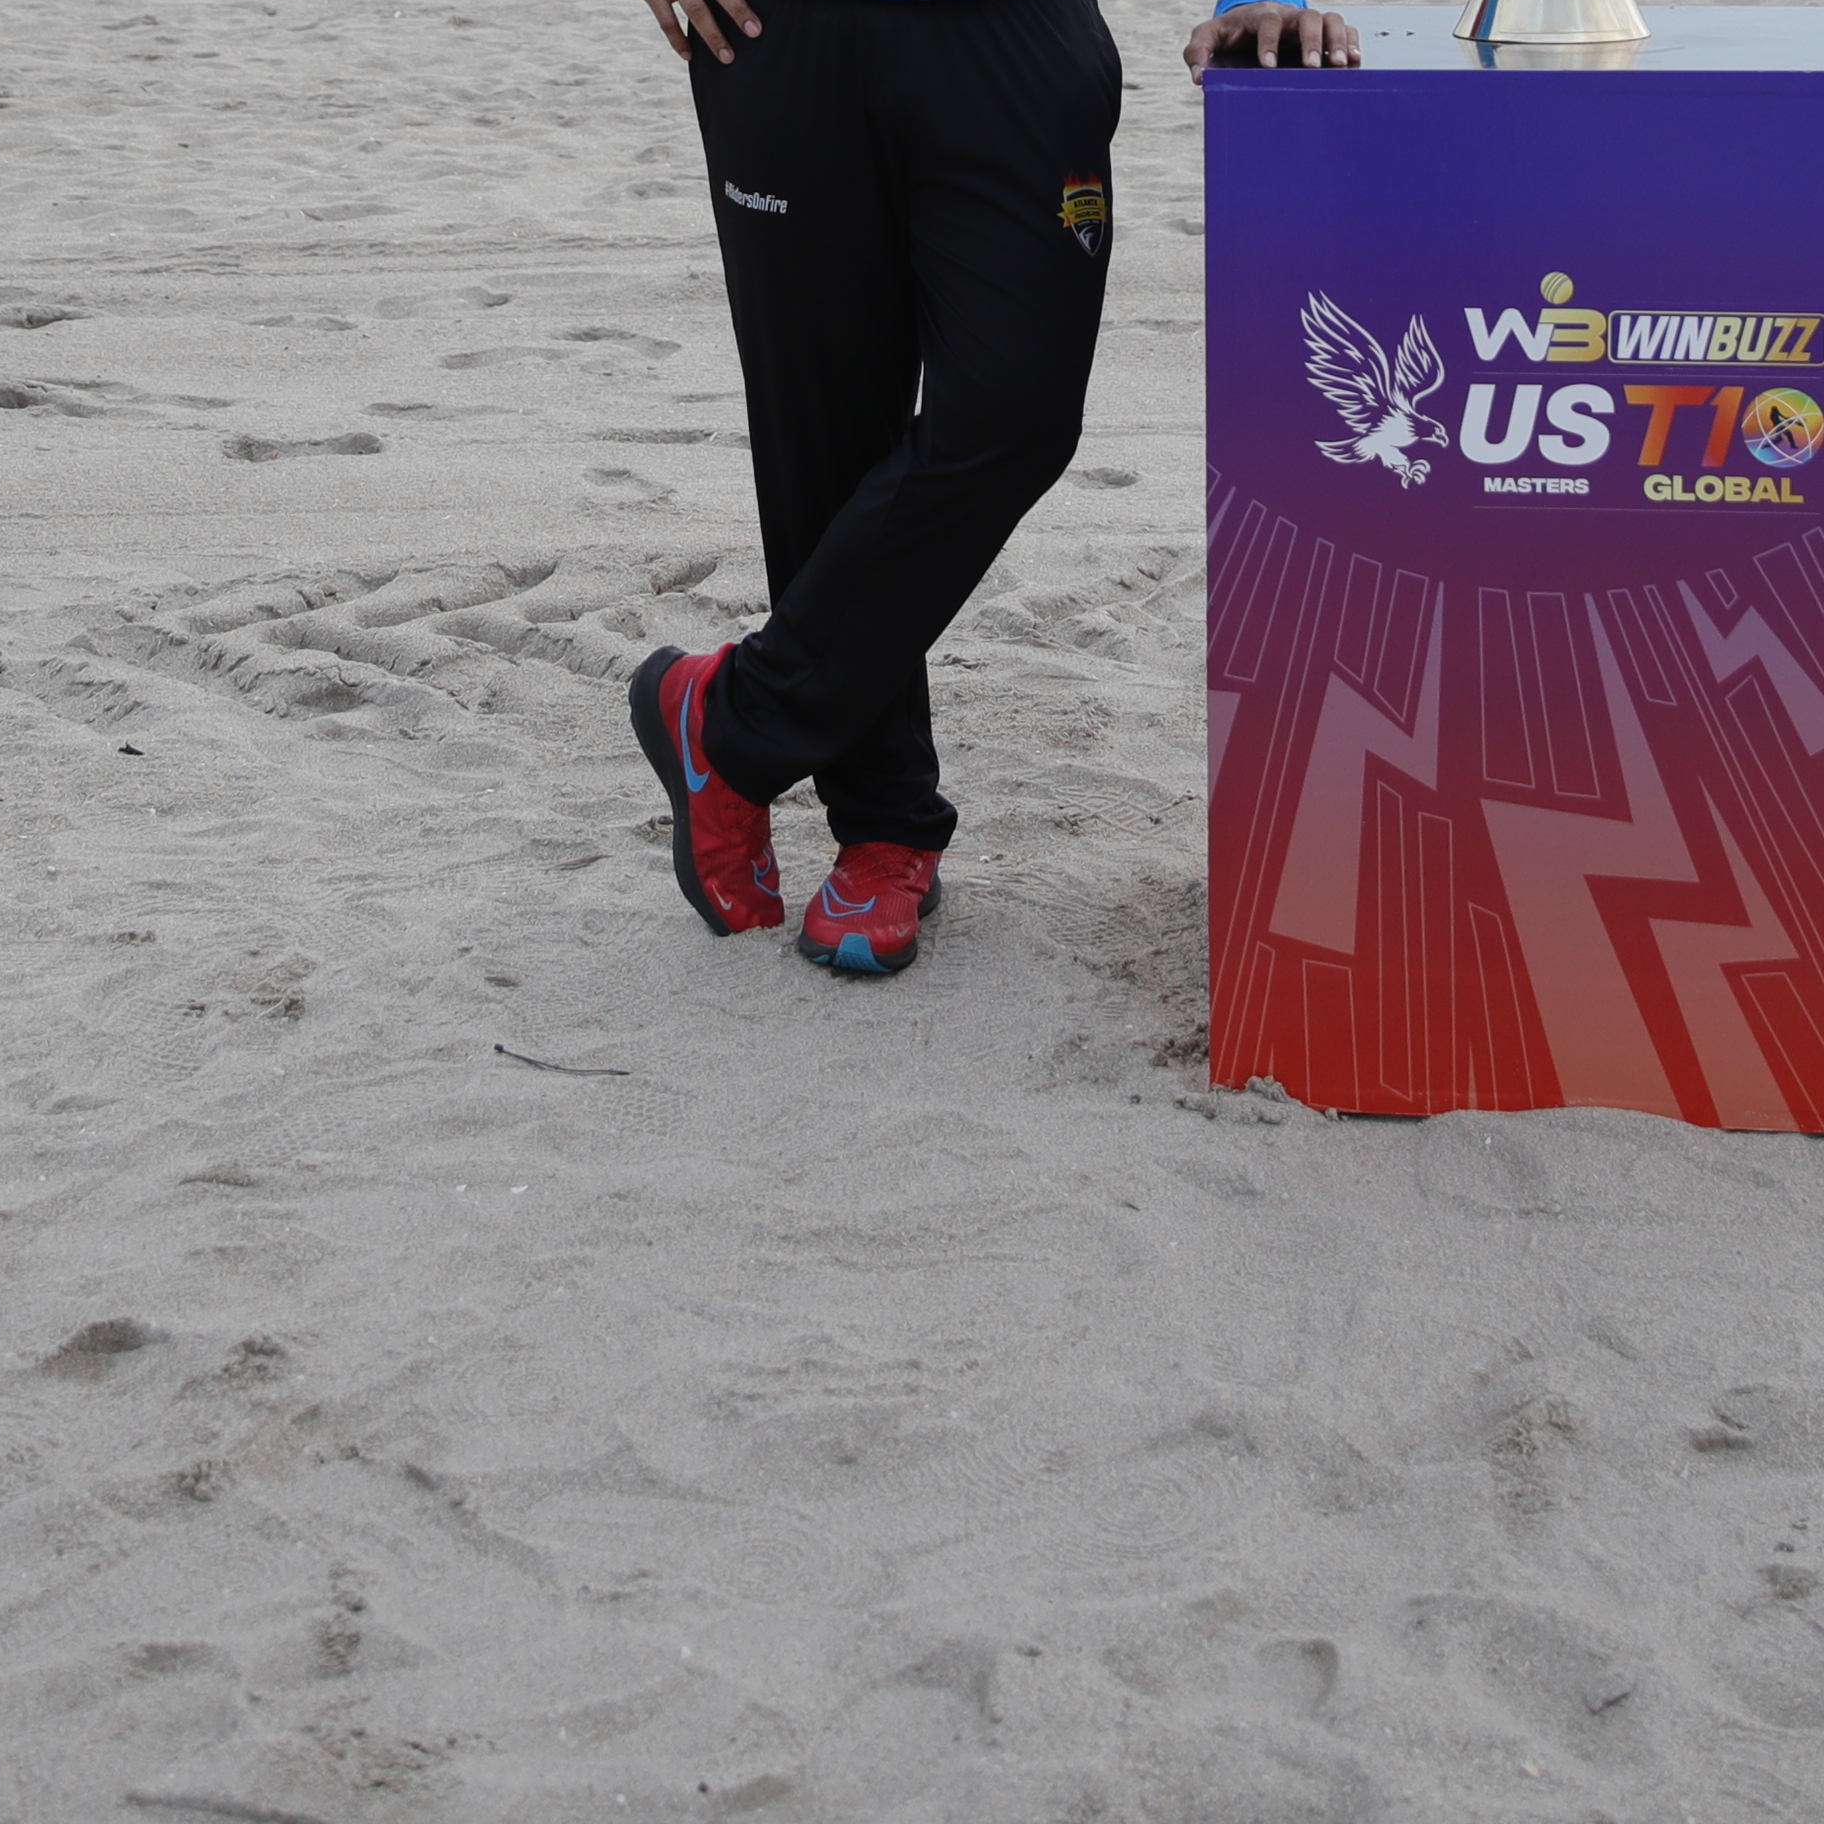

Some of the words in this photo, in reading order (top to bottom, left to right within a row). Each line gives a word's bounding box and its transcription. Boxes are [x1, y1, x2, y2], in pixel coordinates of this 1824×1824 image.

[1616, 315, 1821, 362] WINBUZZ
[1484, 476, 1589, 494] MASTERS
[1643, 474, 1804, 503] GLOBAL
